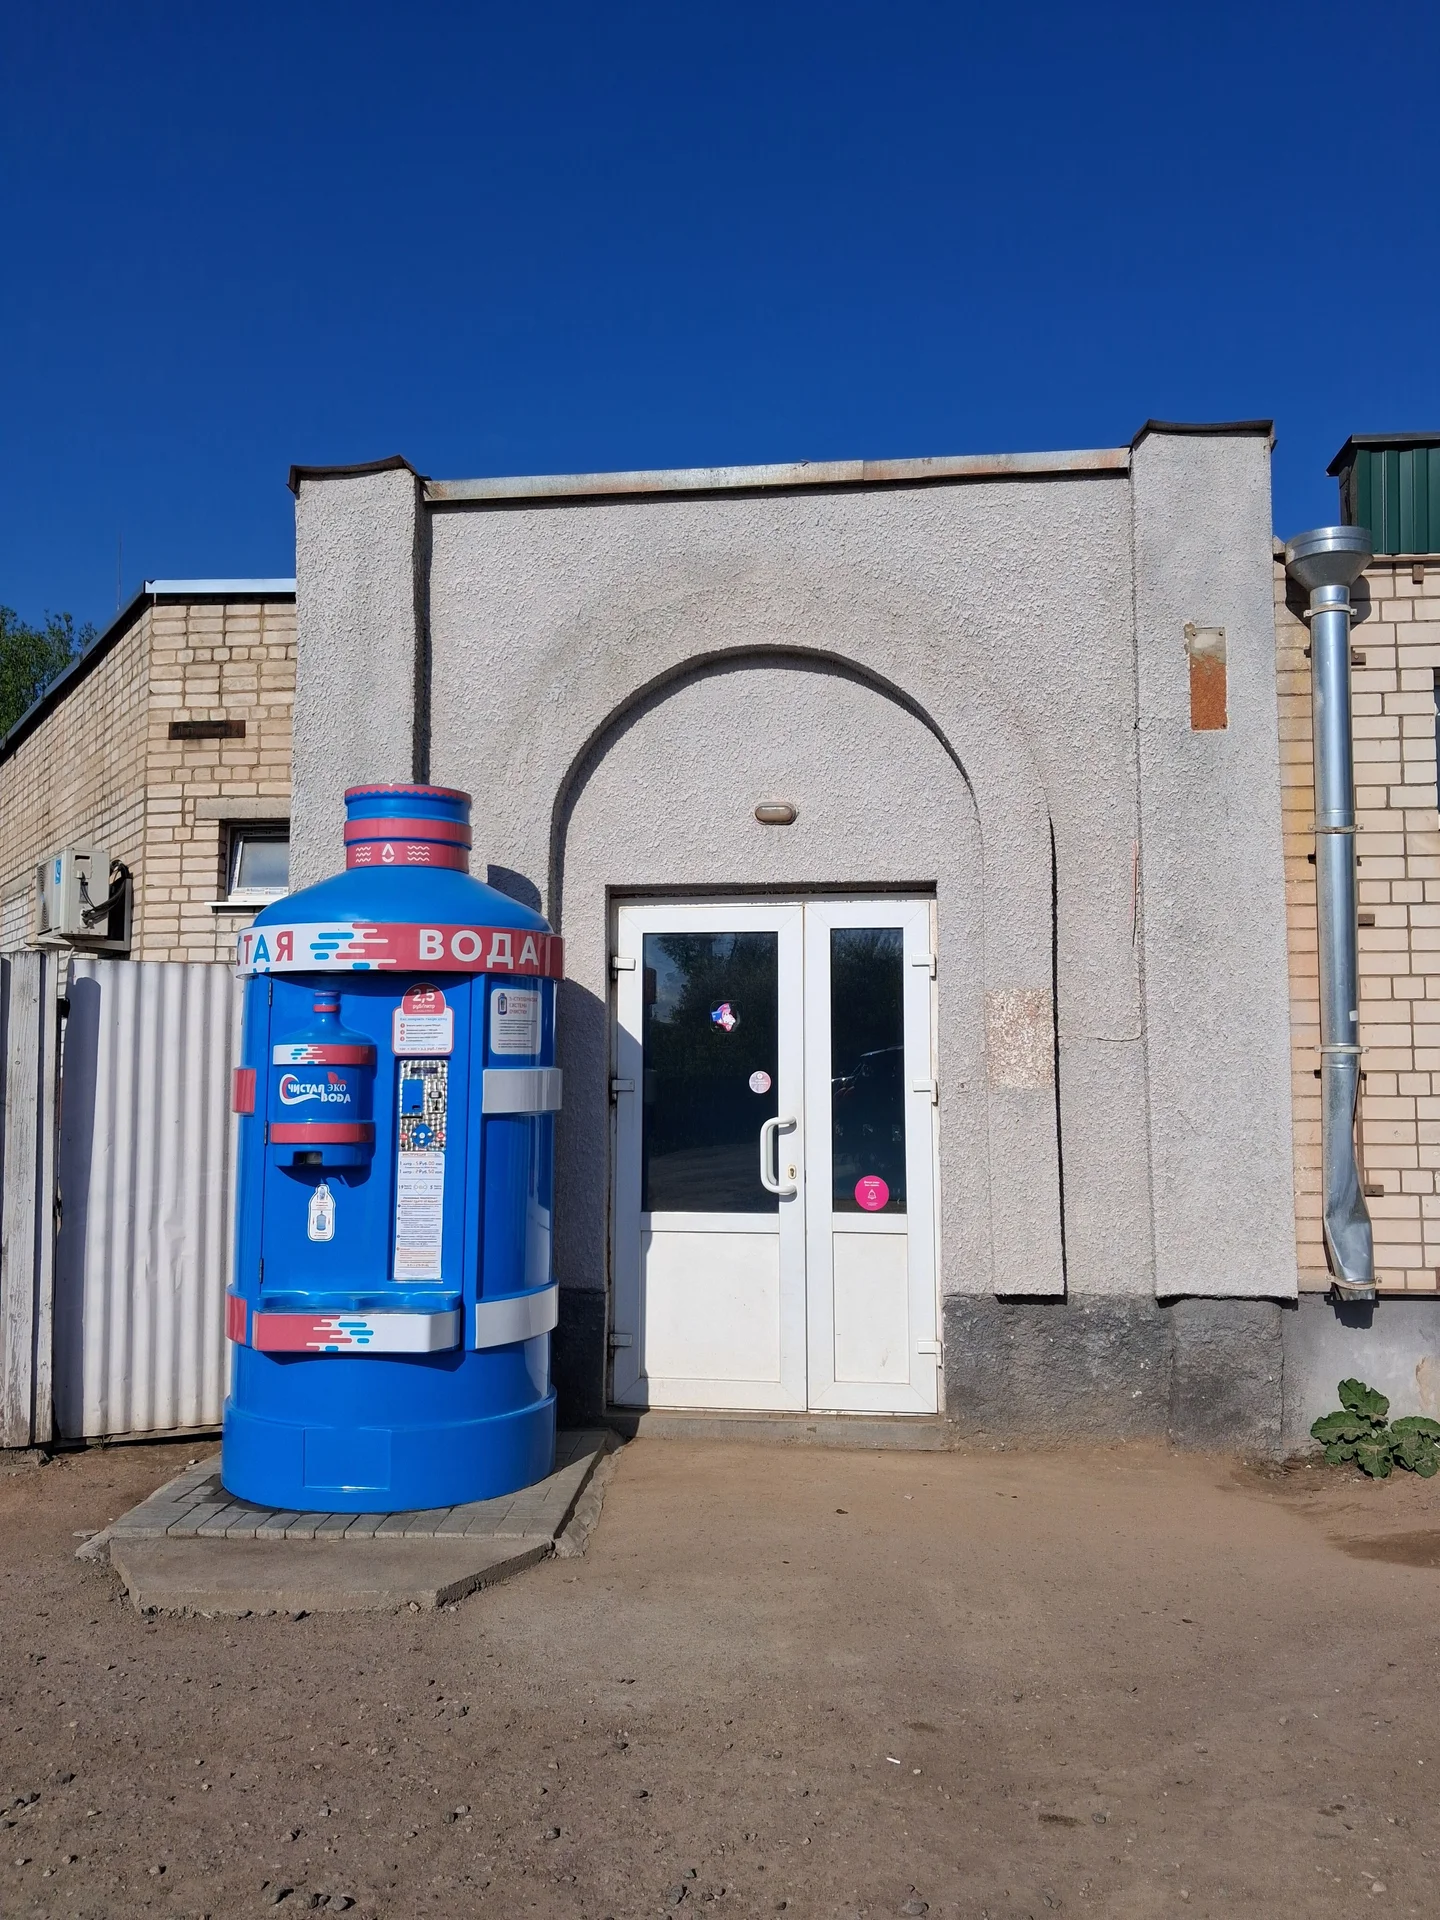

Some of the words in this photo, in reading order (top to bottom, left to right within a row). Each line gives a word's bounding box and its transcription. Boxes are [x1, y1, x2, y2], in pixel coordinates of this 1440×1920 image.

[419, 928, 539, 969] ВОДА
[412, 988, 435, 1003] 2,5
[327, 1083, 346, 1092] ЭКО
[320, 1093, 351, 1104] ВОДА
